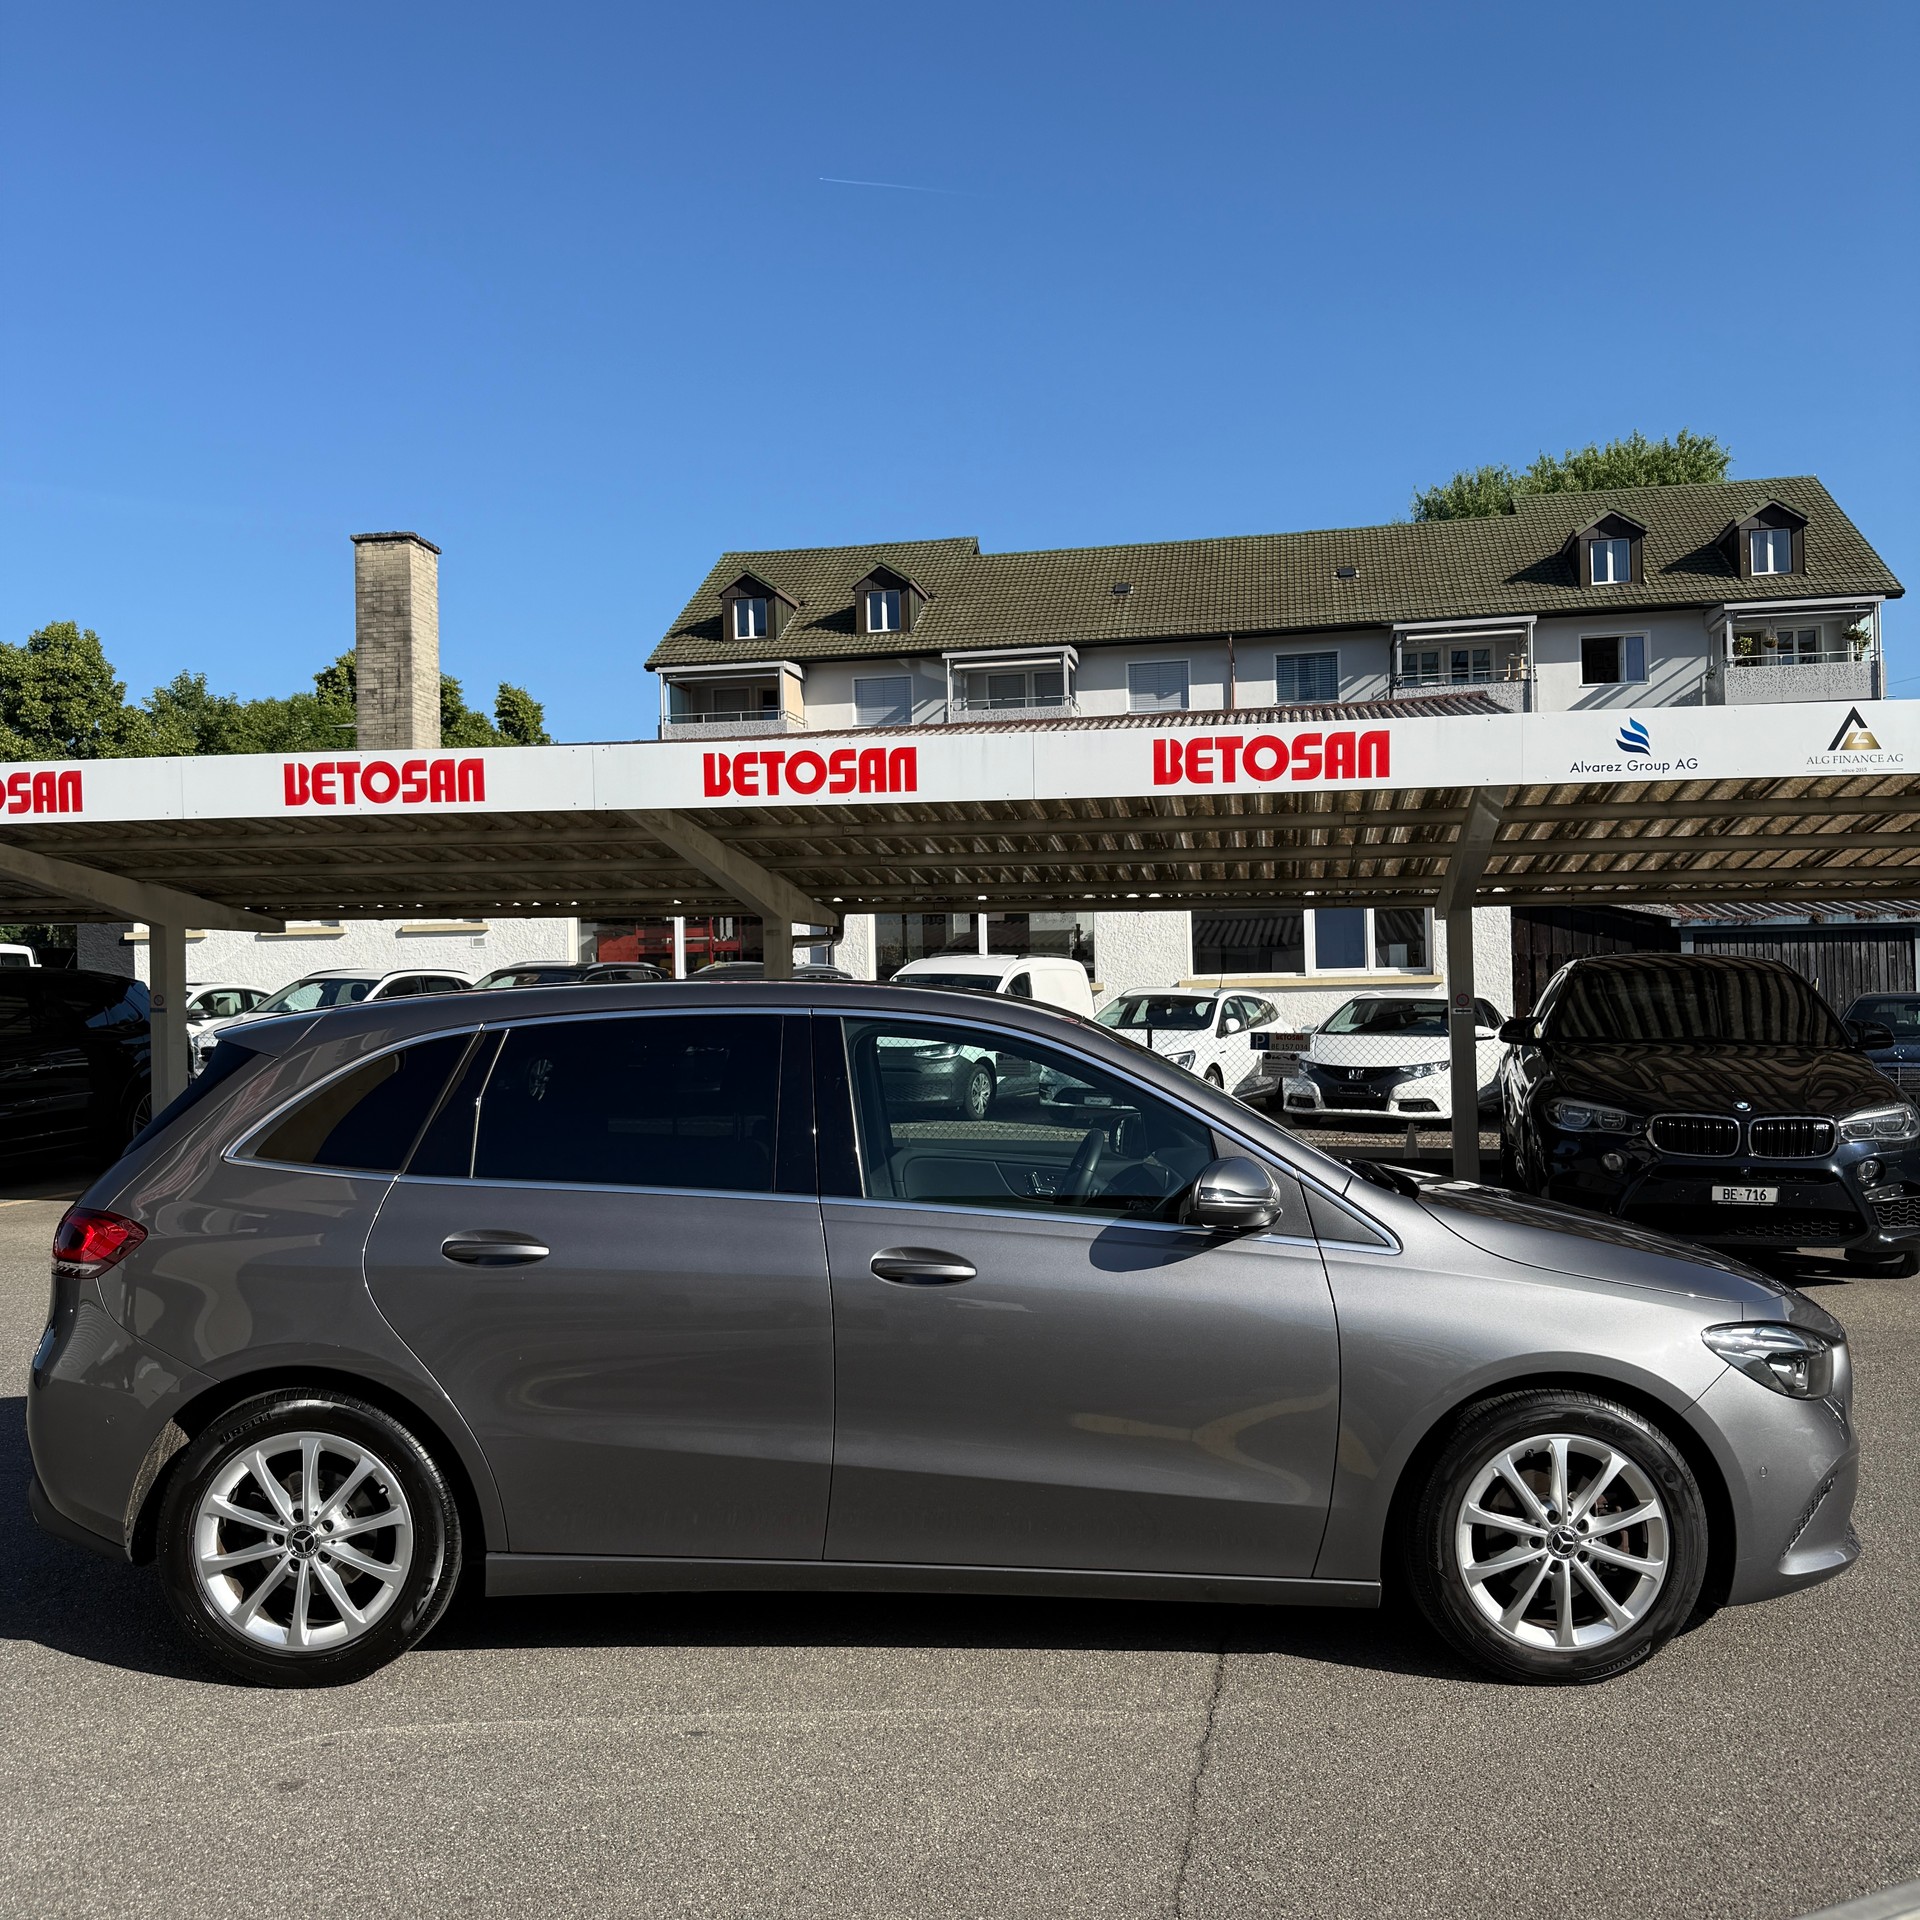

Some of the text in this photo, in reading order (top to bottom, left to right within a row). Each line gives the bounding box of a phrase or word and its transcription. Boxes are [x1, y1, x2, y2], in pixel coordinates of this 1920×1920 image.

[703, 746, 918, 798] BETOSAN
[1153, 730, 1390, 786] BETOSAN
[1570, 758, 1699, 774] Alvarez Group AG
[1806, 753, 1904, 765] ALG FINANCE AG
[0, 770, 83, 814] SAN
[283, 758, 486, 806] BETOSAN
[1255, 1034, 1266, 1049] P
